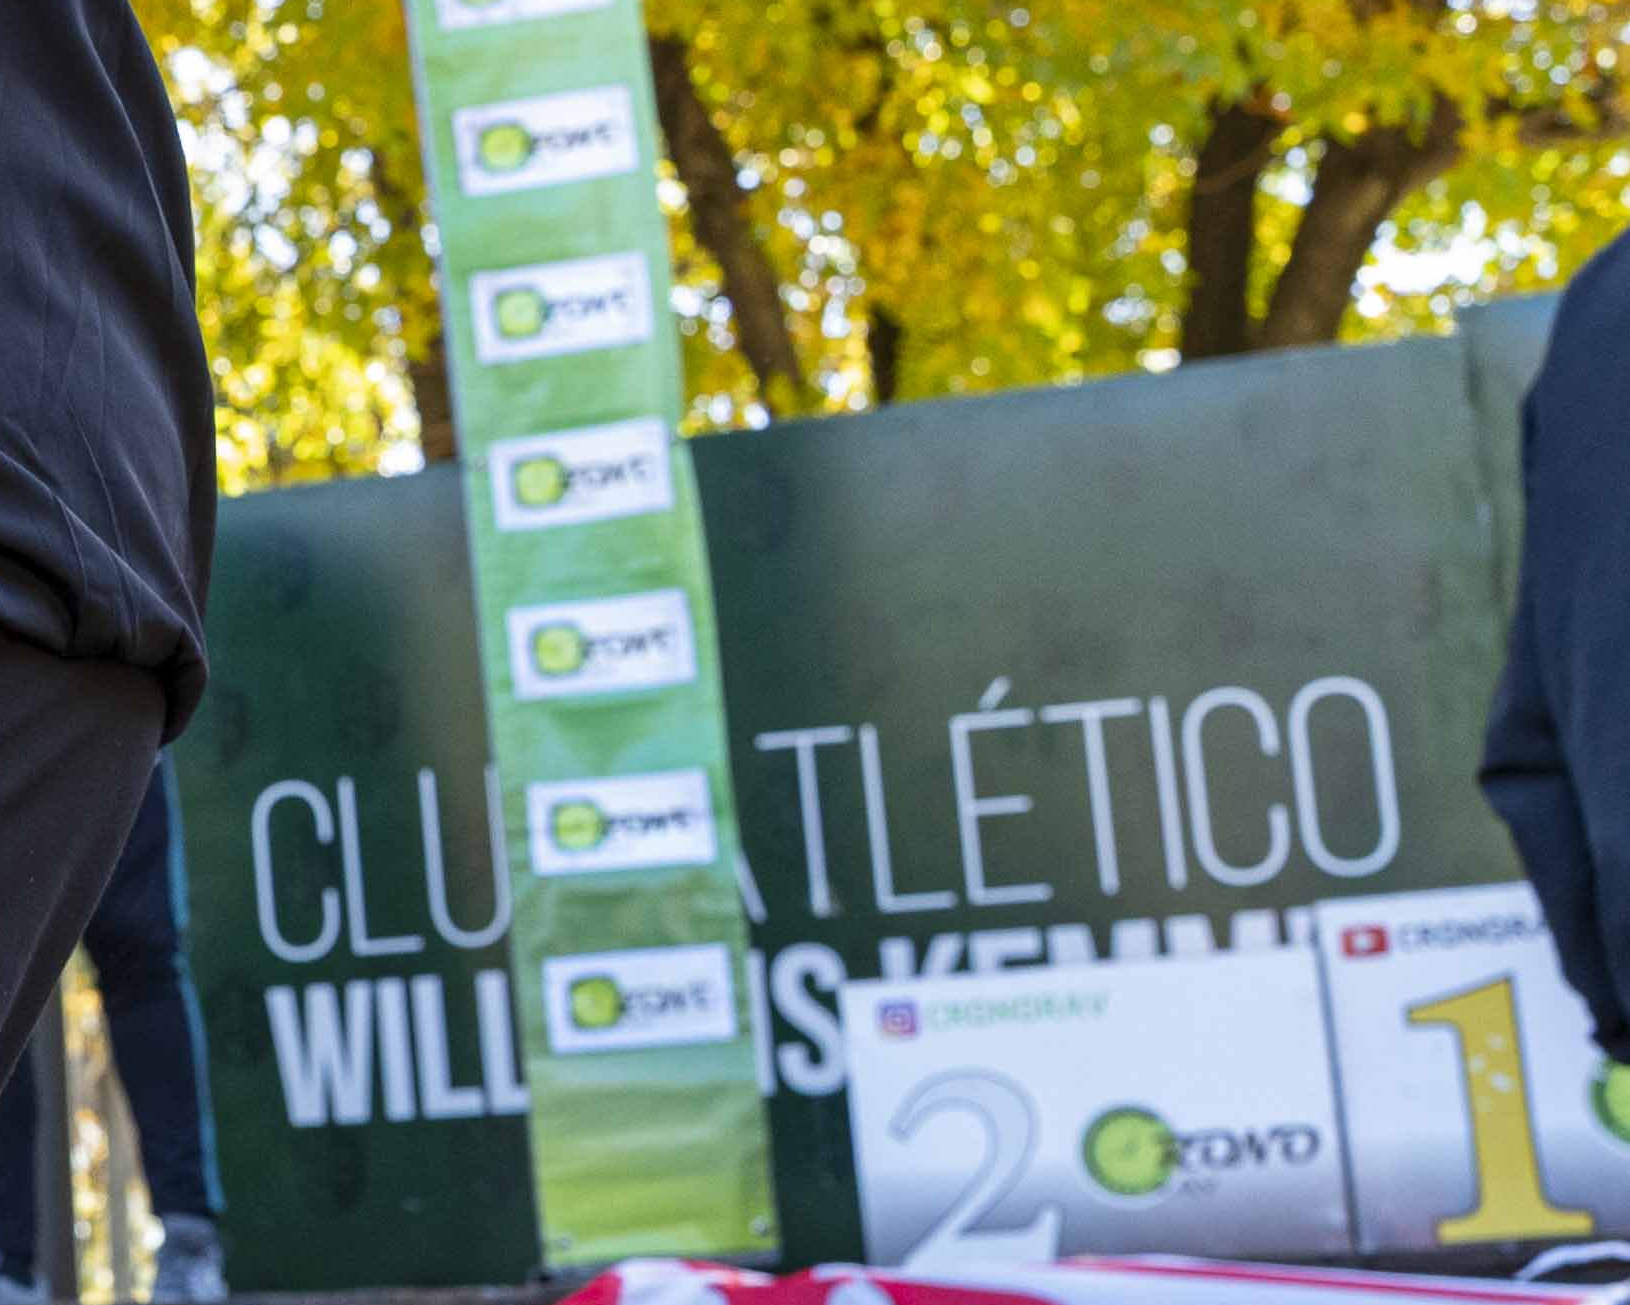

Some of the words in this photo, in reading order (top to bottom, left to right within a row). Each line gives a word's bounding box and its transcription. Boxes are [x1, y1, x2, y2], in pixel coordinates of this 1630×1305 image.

[251, 763, 514, 963] CLU
[889, 1064, 1061, 1269] 2
[1406, 975, 1595, 1242] 1
